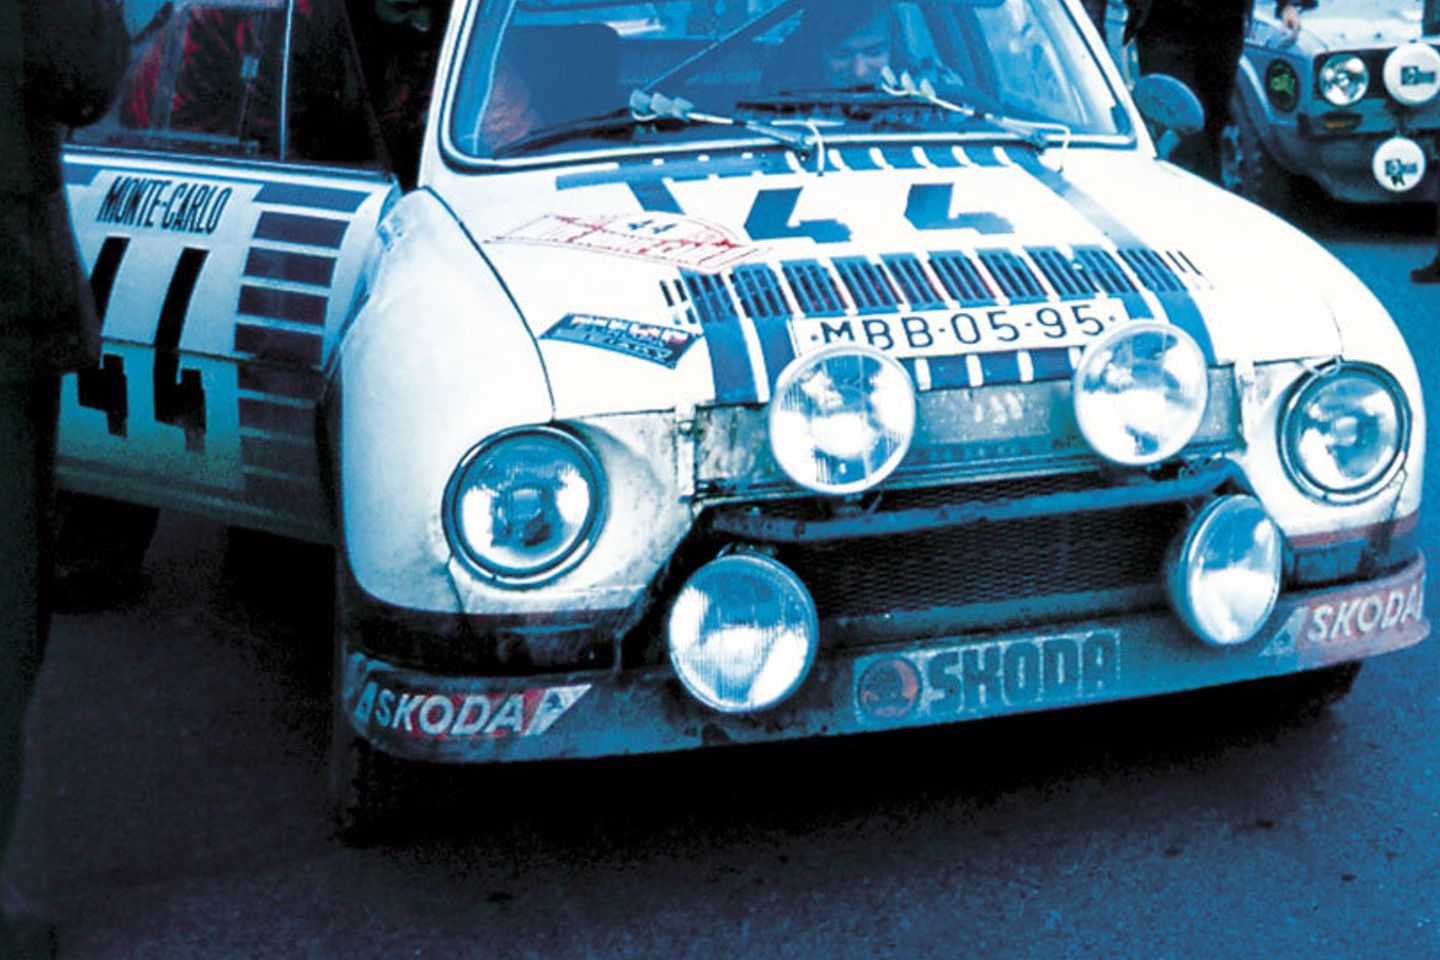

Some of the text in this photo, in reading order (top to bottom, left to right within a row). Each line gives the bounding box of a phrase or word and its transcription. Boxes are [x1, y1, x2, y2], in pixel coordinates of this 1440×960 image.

[96, 174, 234, 235] MONTE-CARLO
[1307, 579, 1423, 642] SKODA
[374, 688, 525, 737] SKODA
